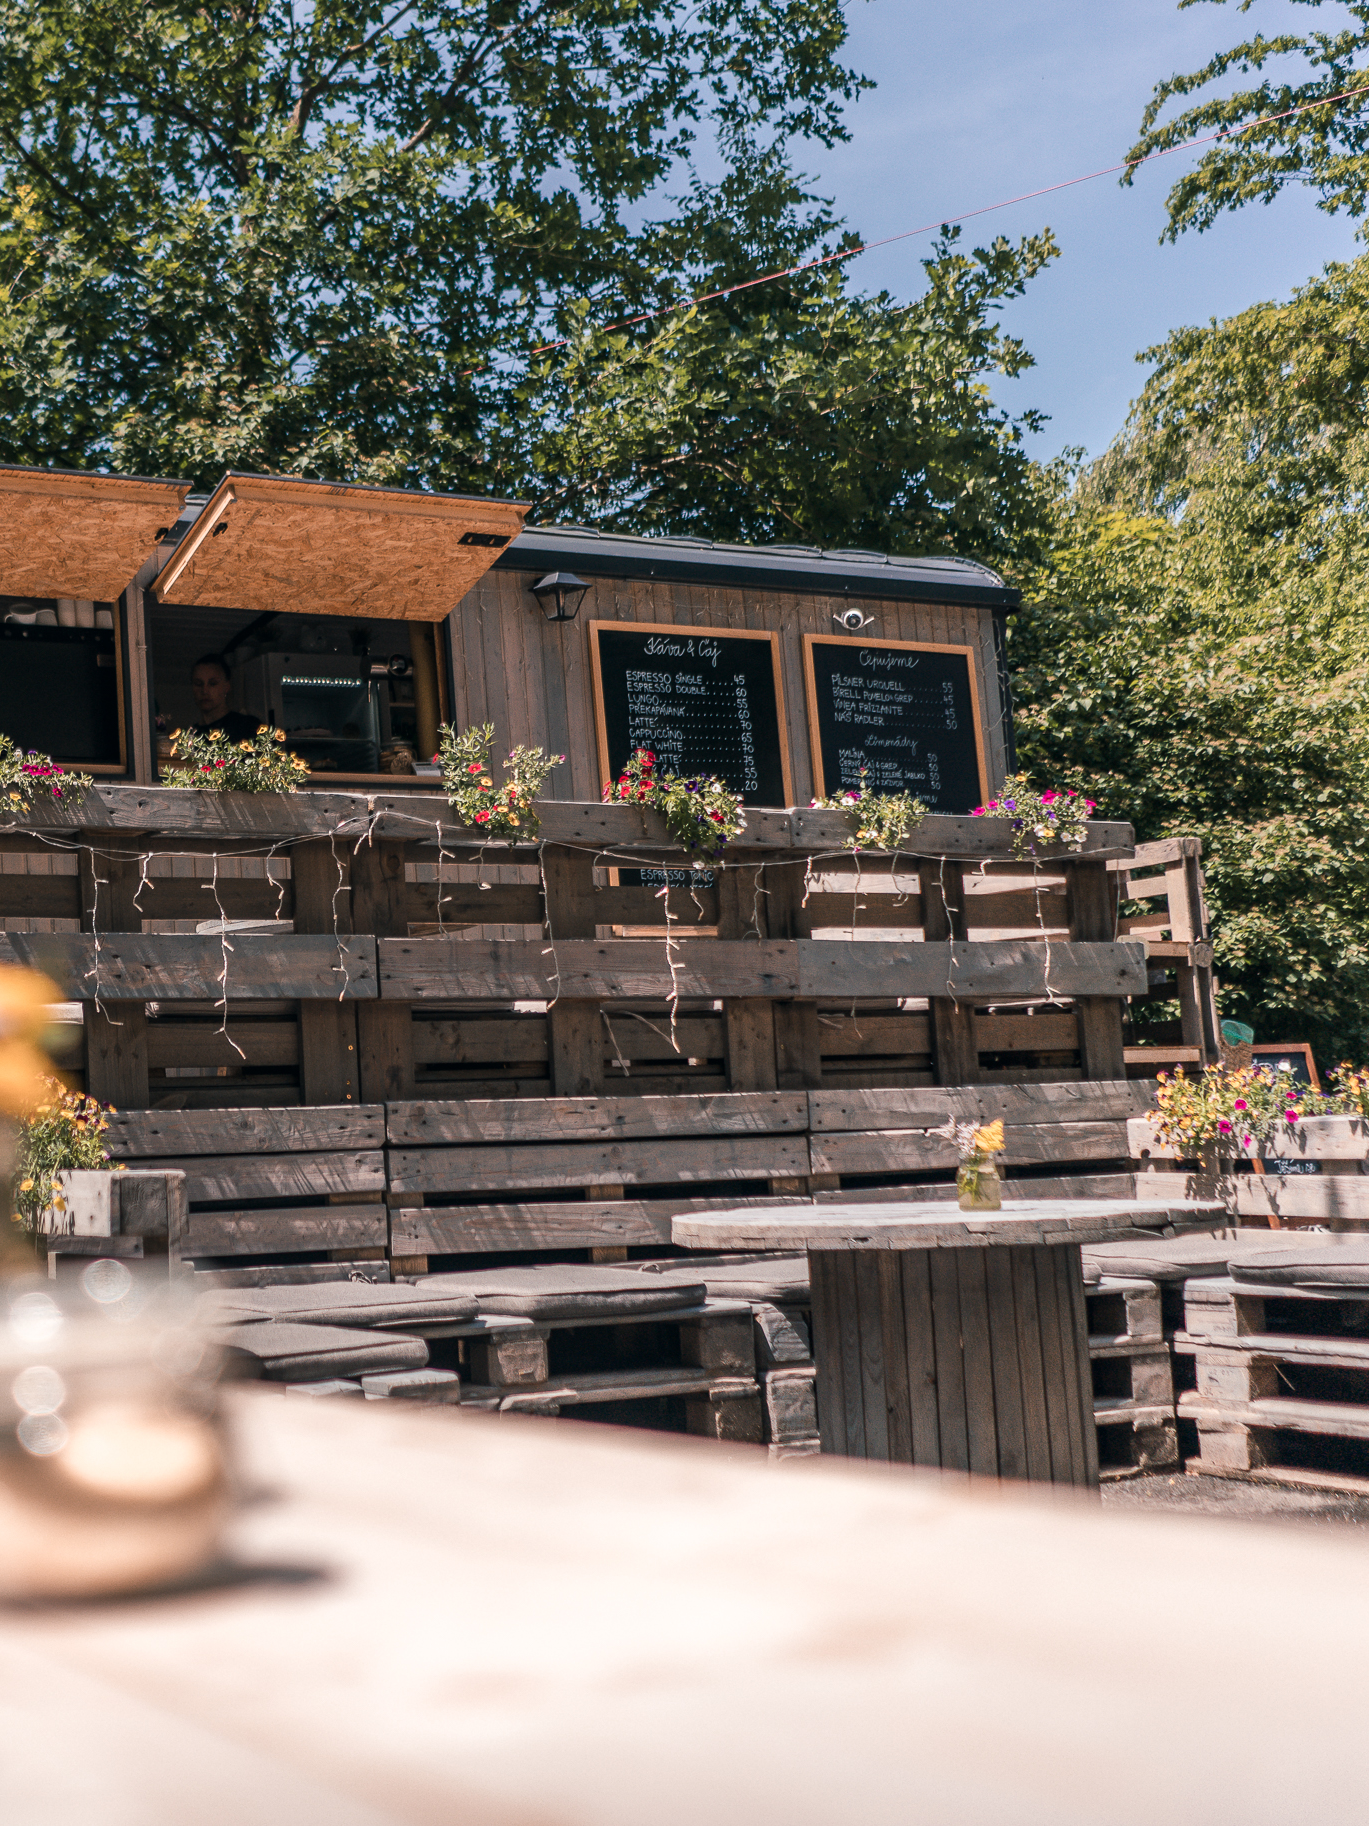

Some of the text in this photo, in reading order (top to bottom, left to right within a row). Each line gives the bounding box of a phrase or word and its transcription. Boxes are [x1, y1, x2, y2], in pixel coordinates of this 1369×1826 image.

[644, 637, 721, 667] Káva & Čaj
[626, 670, 671, 684] ESPRESSO
[734, 674, 745, 685] 45
[626, 682, 746, 697] ESPRESSO DOUBLE 60
[866, 680, 904, 691] URQUELL
[942, 682, 953, 693] 55
[628, 694, 747, 708] LUNGO 55
[944, 696, 953, 705] 45
[738, 710, 749, 719] 60
[944, 708, 955, 718] 45
[740, 722, 752, 730] 70
[854, 714, 884, 726] RADLER
[946, 718, 957, 729] 50
[742, 734, 752, 743] 65
[630, 740, 652, 750] FLAT
[742, 746, 754, 754] 70
[744, 756, 754, 766] 75
[926, 754, 937, 762] 50
[744, 768, 757, 778] 55
[840, 766, 861, 775] ZELEN
[930, 772, 939, 781] 50
[746, 780, 757, 790] 20
[930, 782, 940, 790] 50
[640, 870, 685, 880] ESPRESSO
